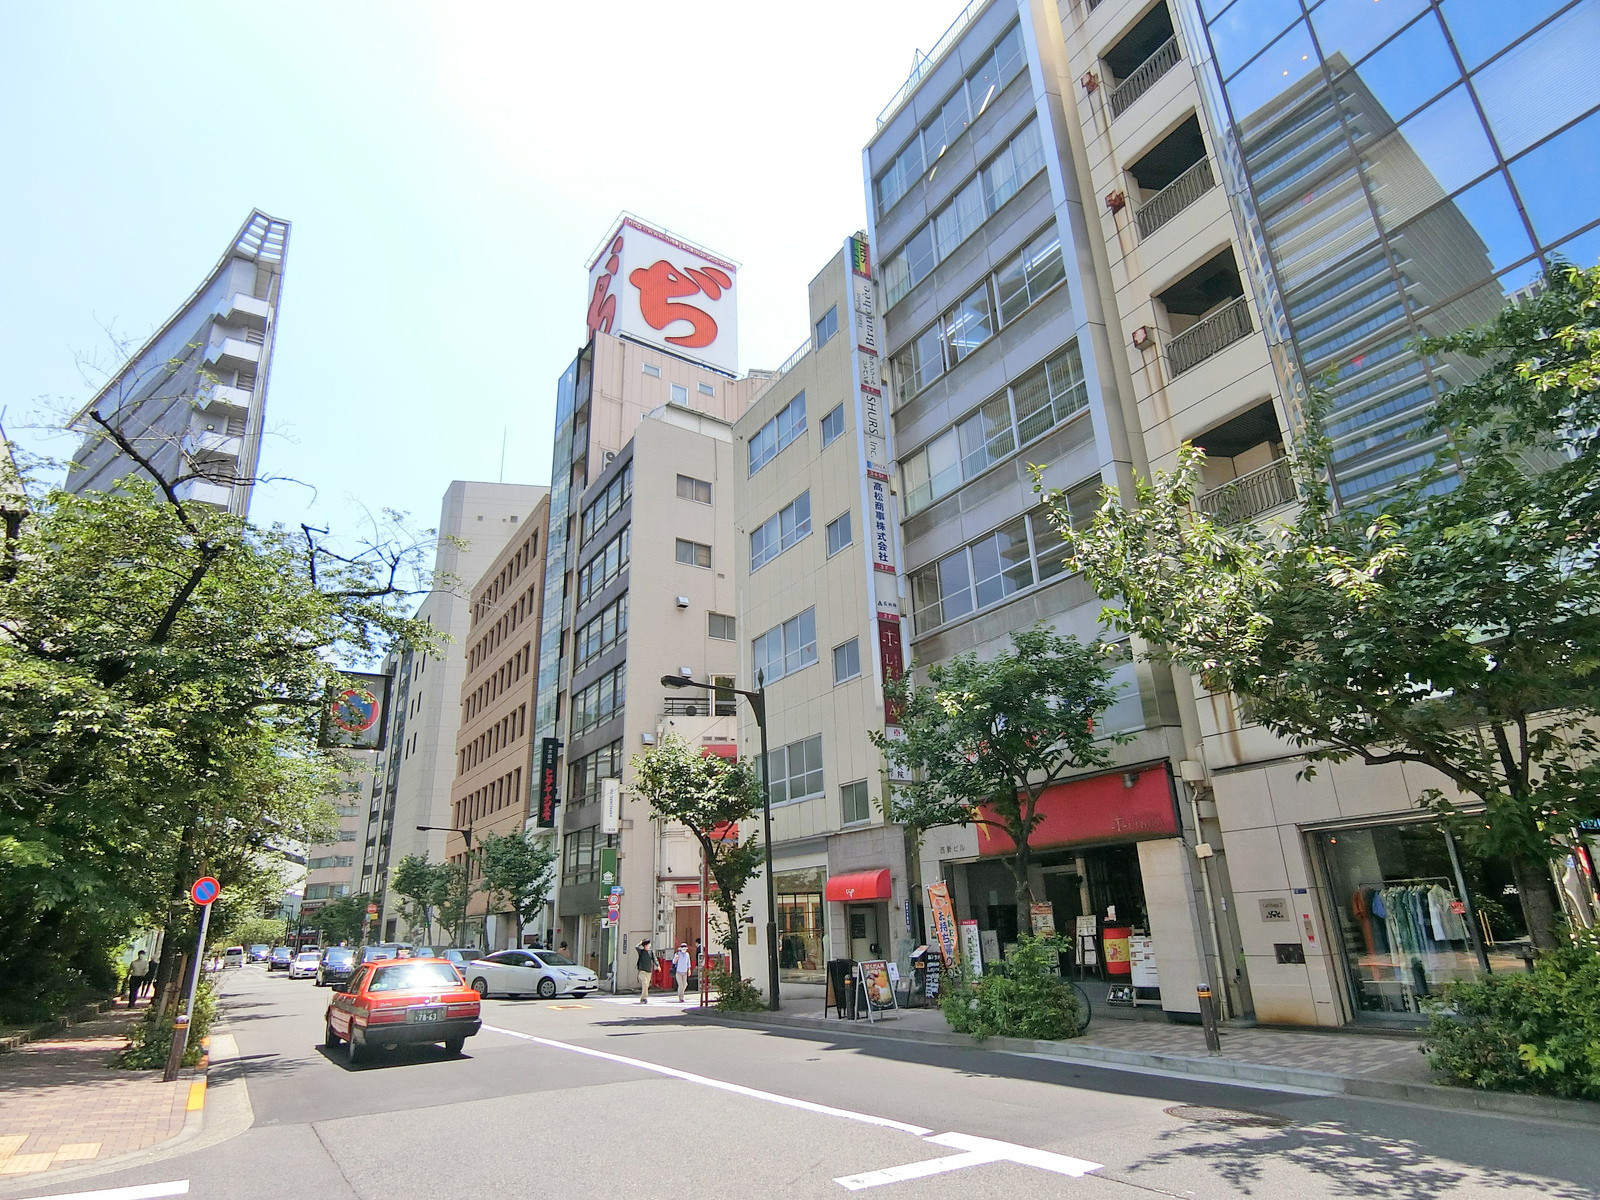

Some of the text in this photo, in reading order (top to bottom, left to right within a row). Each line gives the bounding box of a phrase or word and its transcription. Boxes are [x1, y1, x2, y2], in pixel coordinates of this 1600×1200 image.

[629, 259, 732, 348] ぢ
[873, 481, 889, 563] 高松商事株式会社
